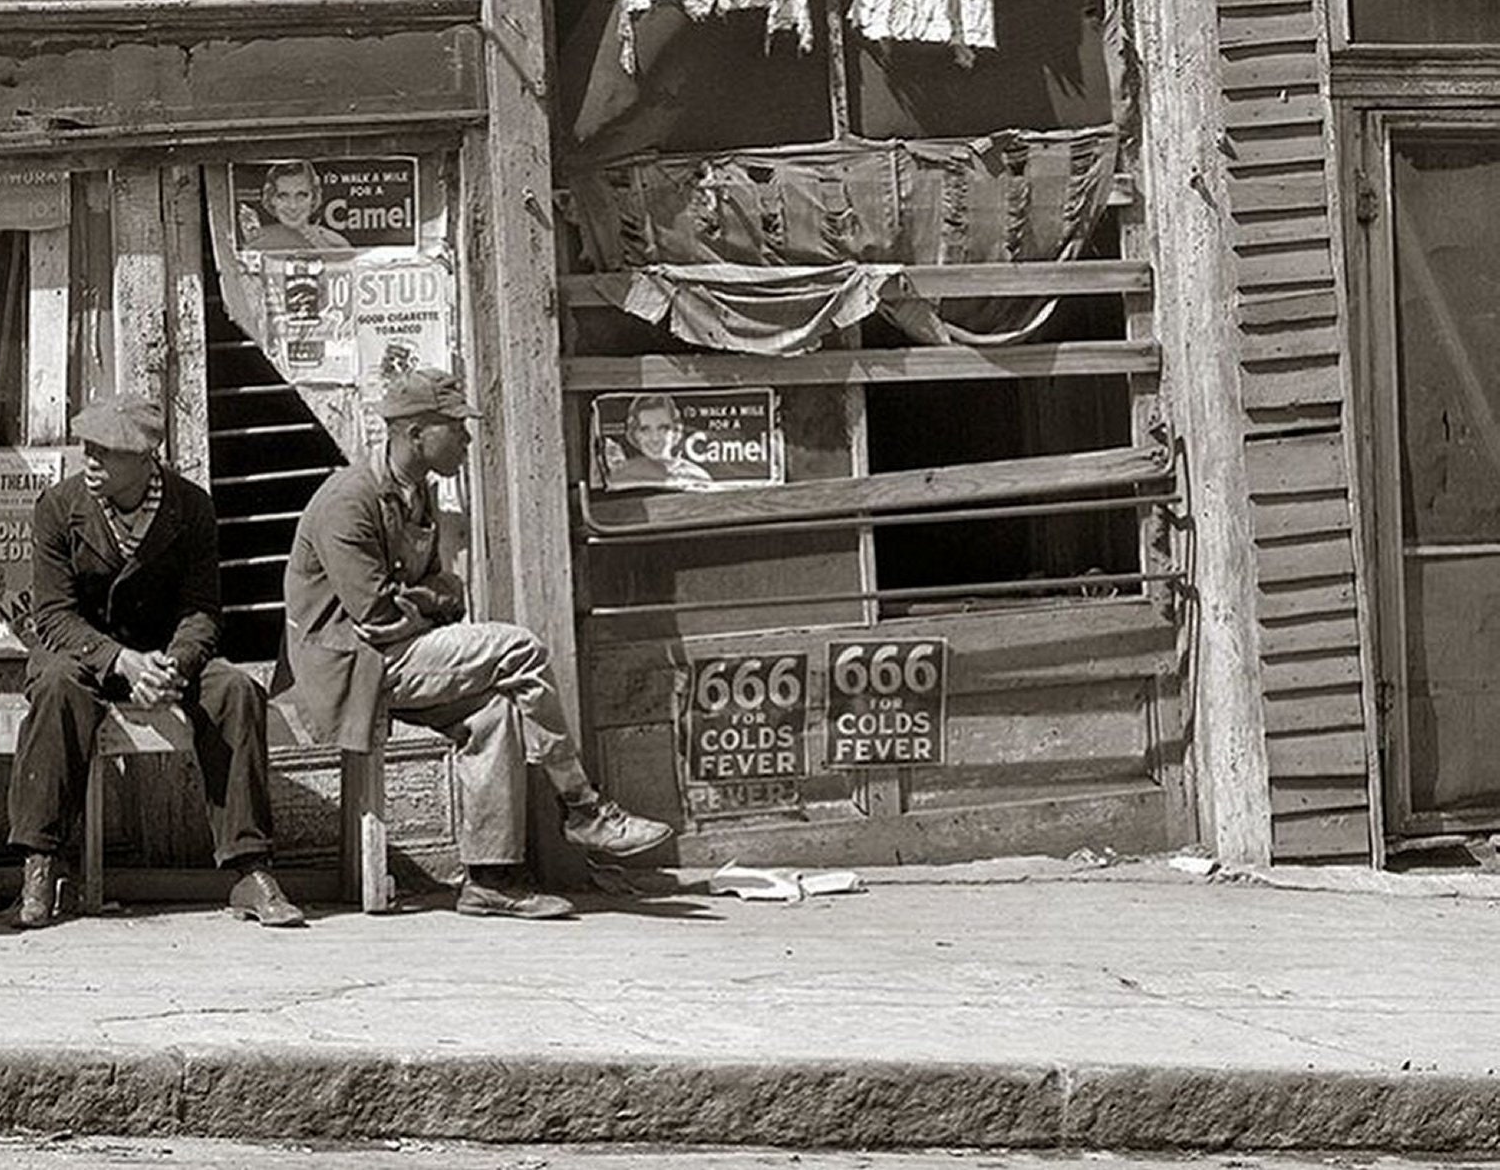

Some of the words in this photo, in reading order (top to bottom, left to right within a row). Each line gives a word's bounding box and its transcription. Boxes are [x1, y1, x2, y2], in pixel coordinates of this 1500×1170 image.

[374, 185, 385, 196] A
[324, 197, 412, 230] Camel
[358, 271, 439, 307] STUD
[357, 313, 385, 325] GOOD
[387, 311, 440, 323] CIGARETTE
[375, 324, 422, 336] TOBACCO
[685, 431, 767, 463] Camel
[0, 541, 34, 561] EDD
[834, 644, 938, 695] 666
[697, 656, 801, 711] 666
[869, 697, 903, 711] FOR
[731, 712, 767, 726] FOR
[836, 712, 931, 735] COLDS
[700, 726, 795, 751] COLDS
[835, 737, 933, 761] FEVER
[699, 752, 796, 777] FEVER
